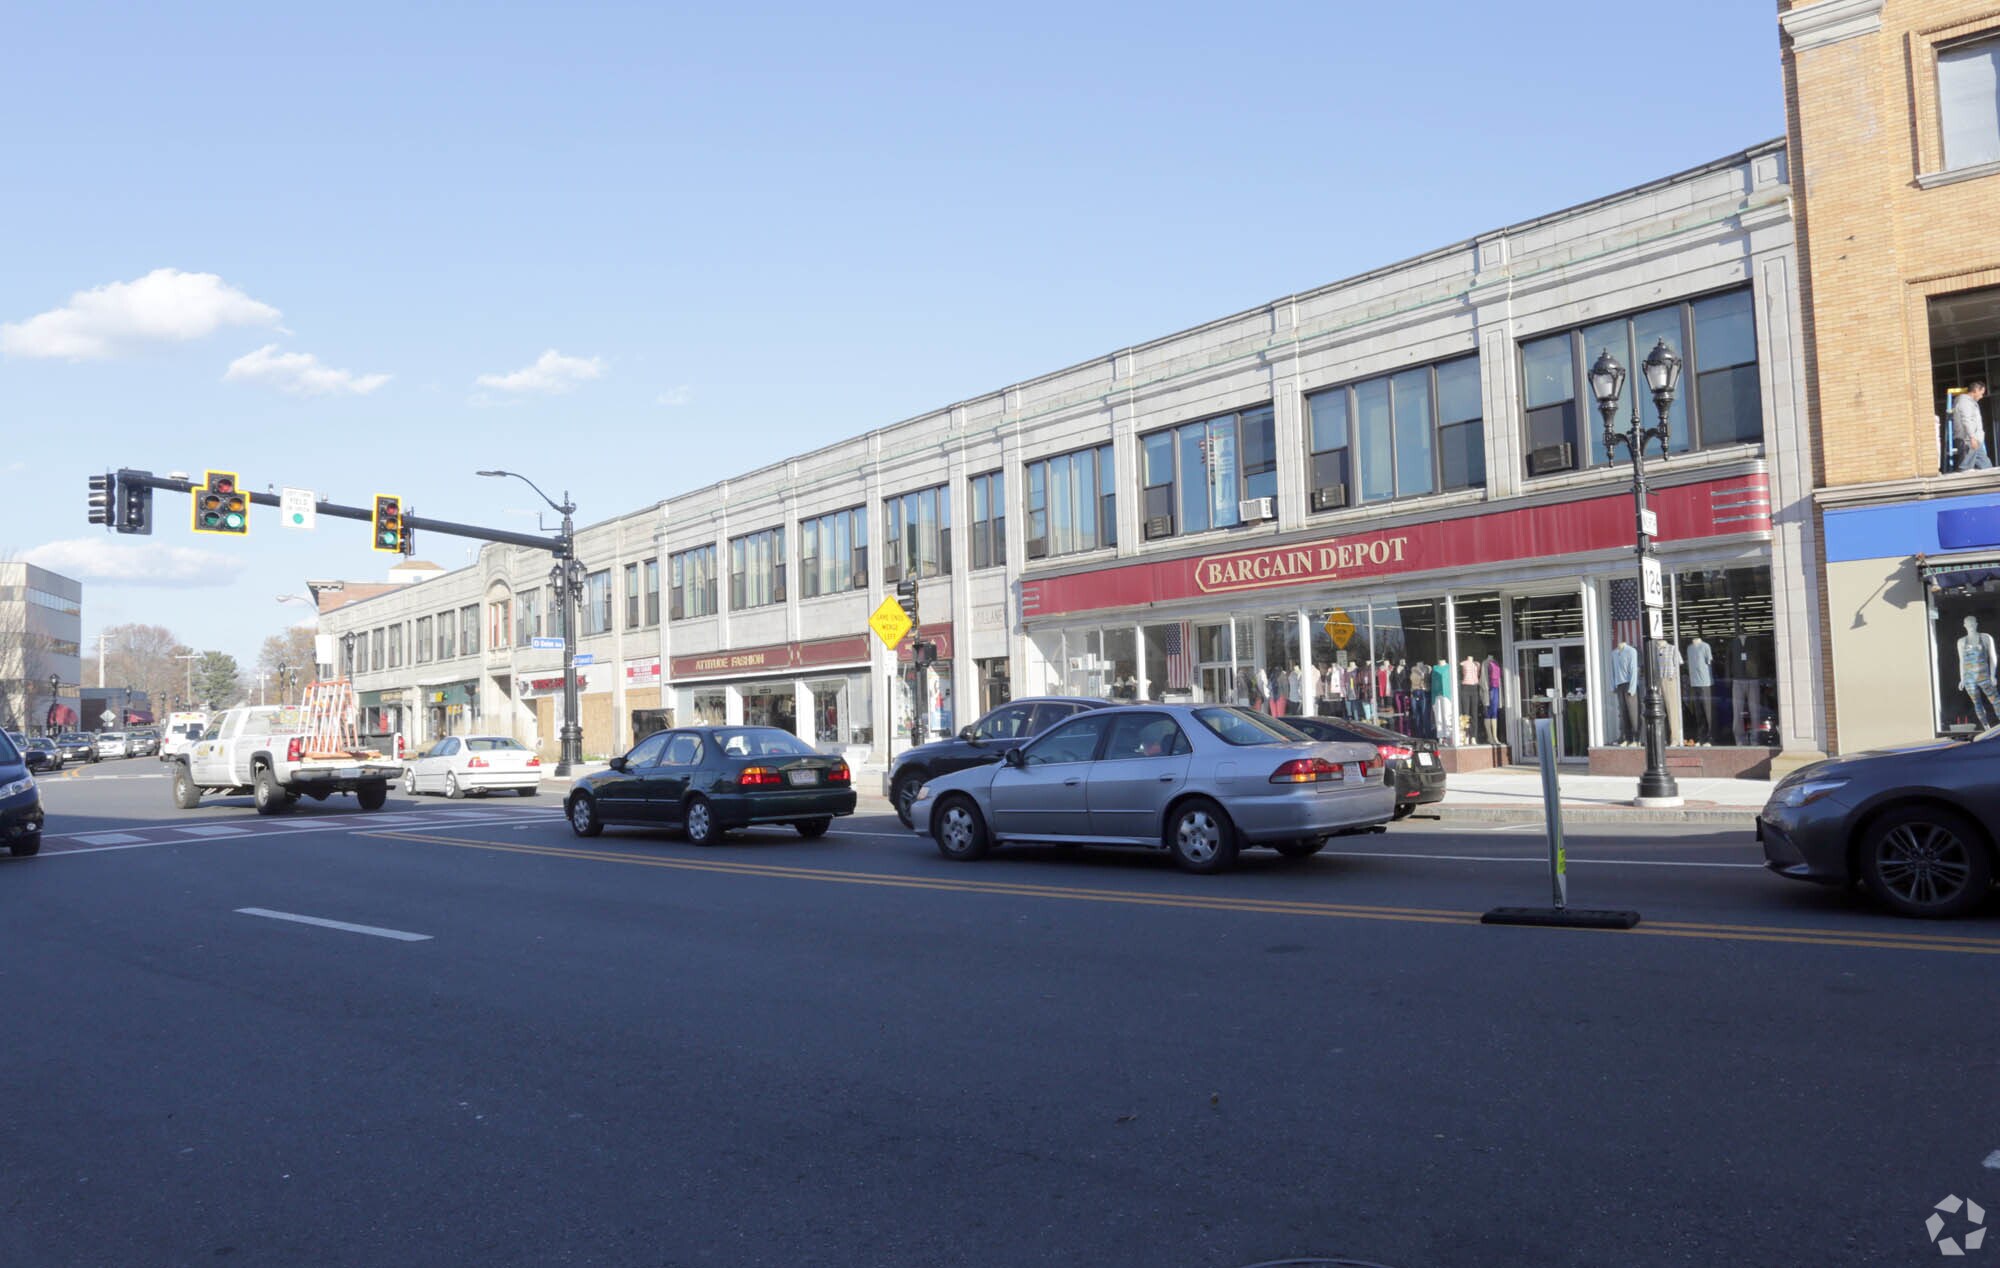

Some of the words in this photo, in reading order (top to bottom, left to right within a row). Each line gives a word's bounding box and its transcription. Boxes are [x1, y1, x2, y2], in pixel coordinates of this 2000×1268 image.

[1207, 550, 1313, 585] BARGAIN
[1319, 536, 1408, 572] DEPOT
[1645, 568, 1662, 595] 126
[695, 657, 729, 671] ATTITUDE
[731, 653, 765, 668] FASHION
